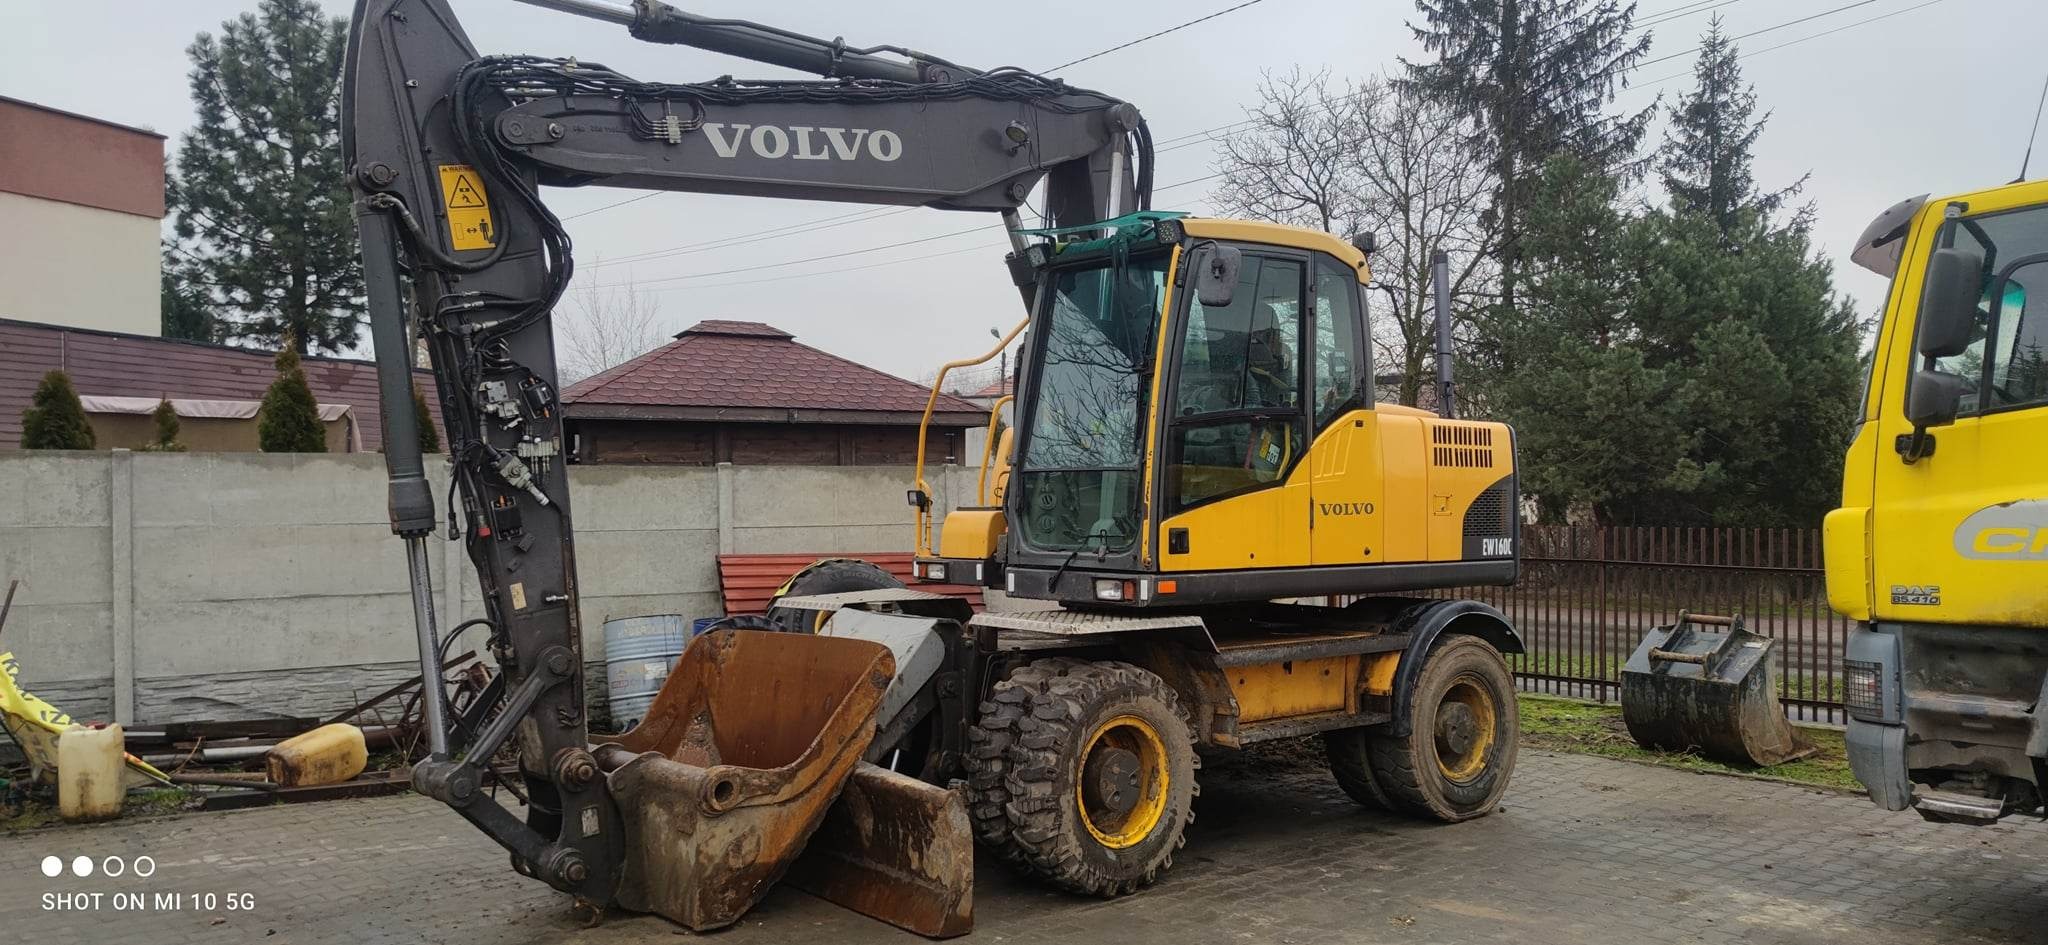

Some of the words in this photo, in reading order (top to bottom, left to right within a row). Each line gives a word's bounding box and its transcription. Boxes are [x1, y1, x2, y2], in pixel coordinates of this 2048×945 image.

[702, 122, 902, 162] VOLVO
[1320, 502, 1374, 516] VOLVO
[1482, 538, 1512, 556] EW160C
[1891, 585, 1939, 595] DAF
